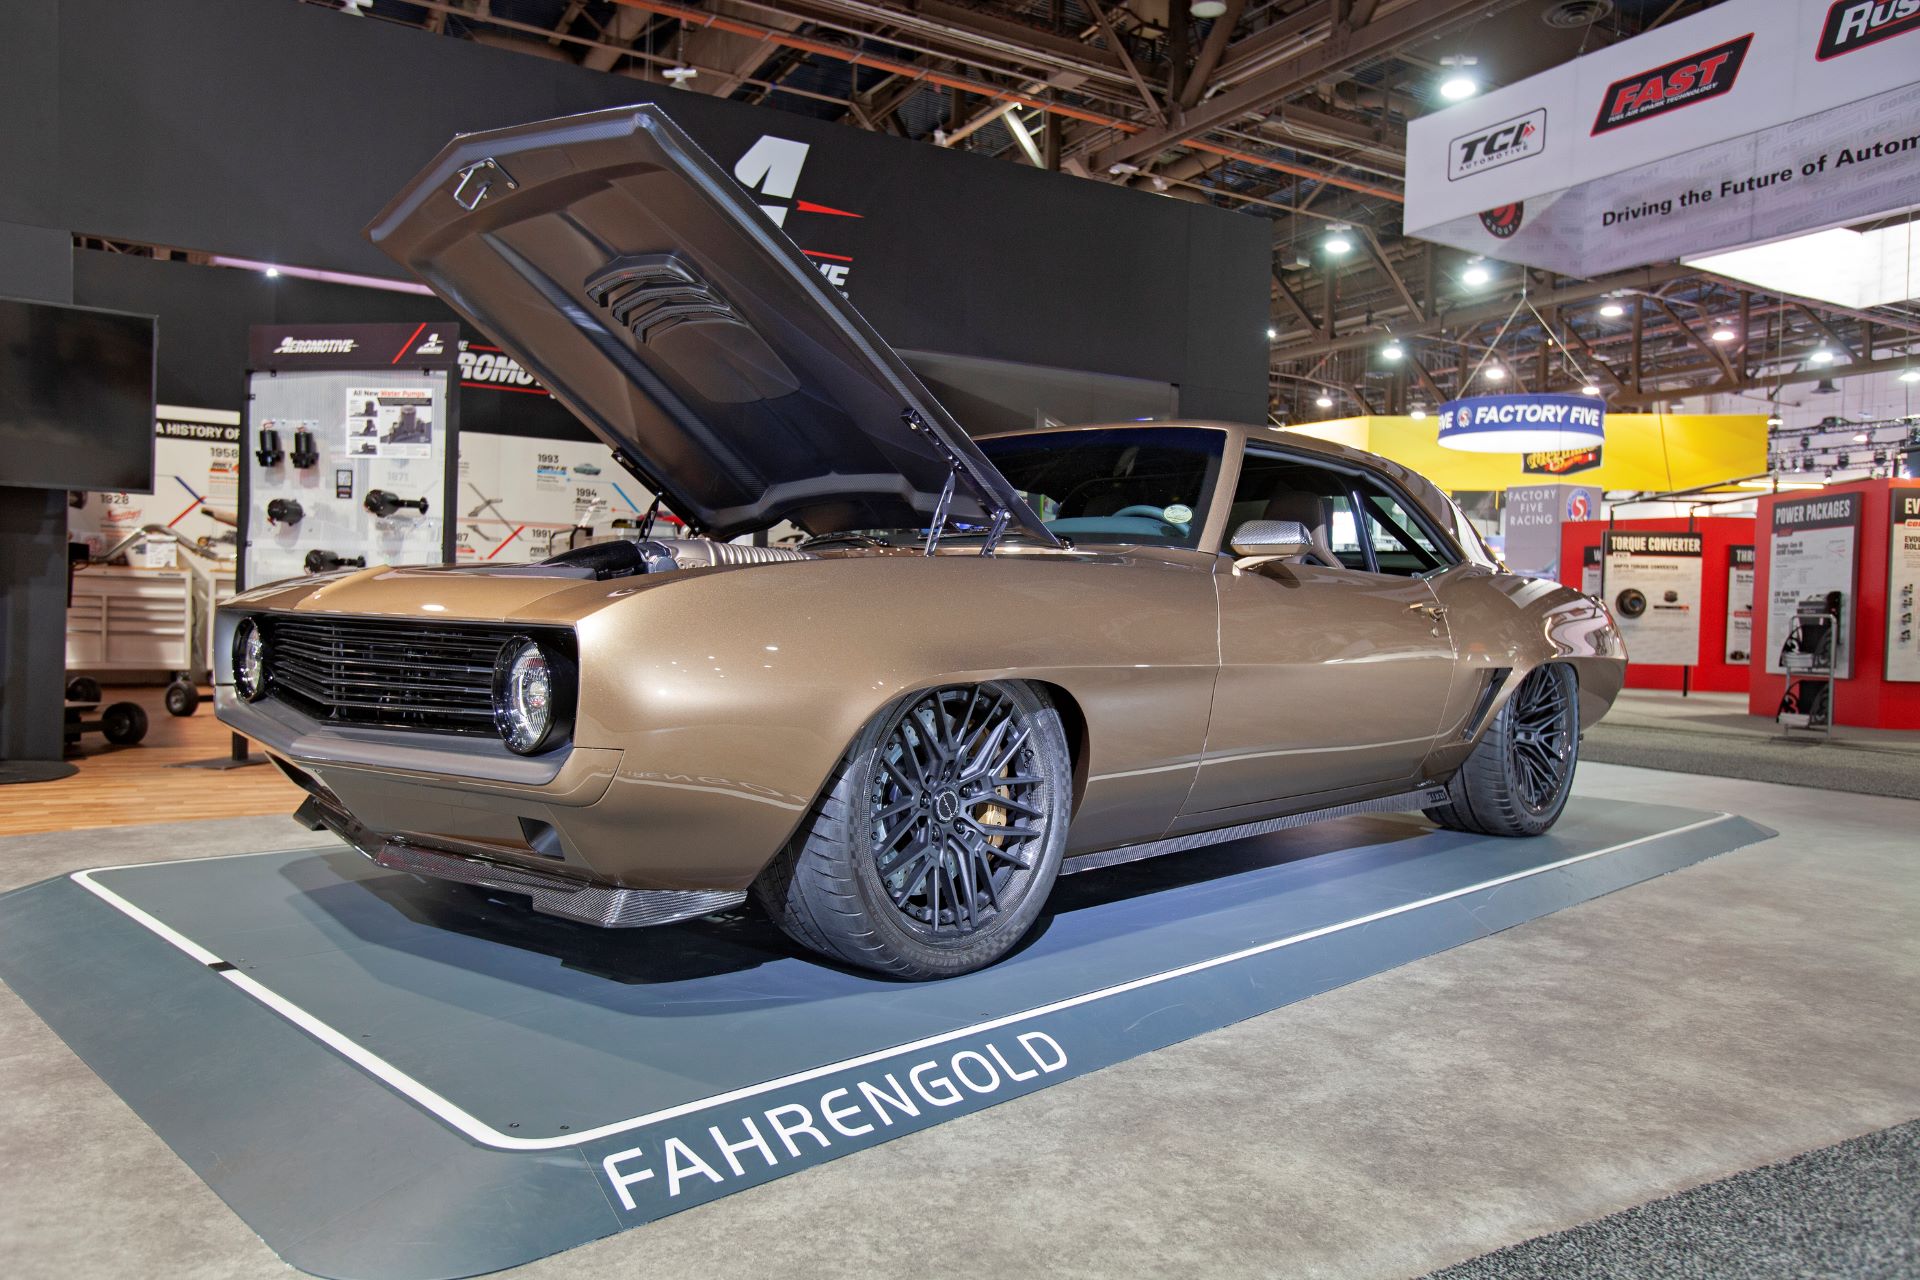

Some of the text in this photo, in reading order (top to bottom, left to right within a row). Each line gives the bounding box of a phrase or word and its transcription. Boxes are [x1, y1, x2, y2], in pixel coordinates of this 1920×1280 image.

[1611, 52, 1729, 115] FAST
[1608, 82, 1719, 123] FUEL AIR SPARK TECHNOLOGY
[1461, 121, 1531, 164] TCI
[1459, 144, 1529, 171] AUTOMOTIVE
[1602, 200, 1672, 227] Driving
[1679, 190, 1713, 207] the
[1720, 168, 1793, 198] Future
[1802, 155, 1828, 176] of
[273, 336, 358, 353] AEROMOTIVE
[402, 390, 425, 399] Pumps
[1475, 404, 1569, 425] FACTORY
[1569, 406, 1599, 427] FIVE
[166, 423, 223, 439] HISTORY
[537, 453, 559, 463] 1993
[576, 487, 597, 497] 1994
[1509, 489, 1556, 501] FACTORY
[1520, 502, 1543, 513] FIVE
[1775, 499, 1851, 525] POWER PACKAGES
[1510, 514, 1552, 526] RACING
[1611, 536, 1701, 553] TORQUE CONVERTER
[603, 1031, 1069, 1211] FAHRENGOLD
